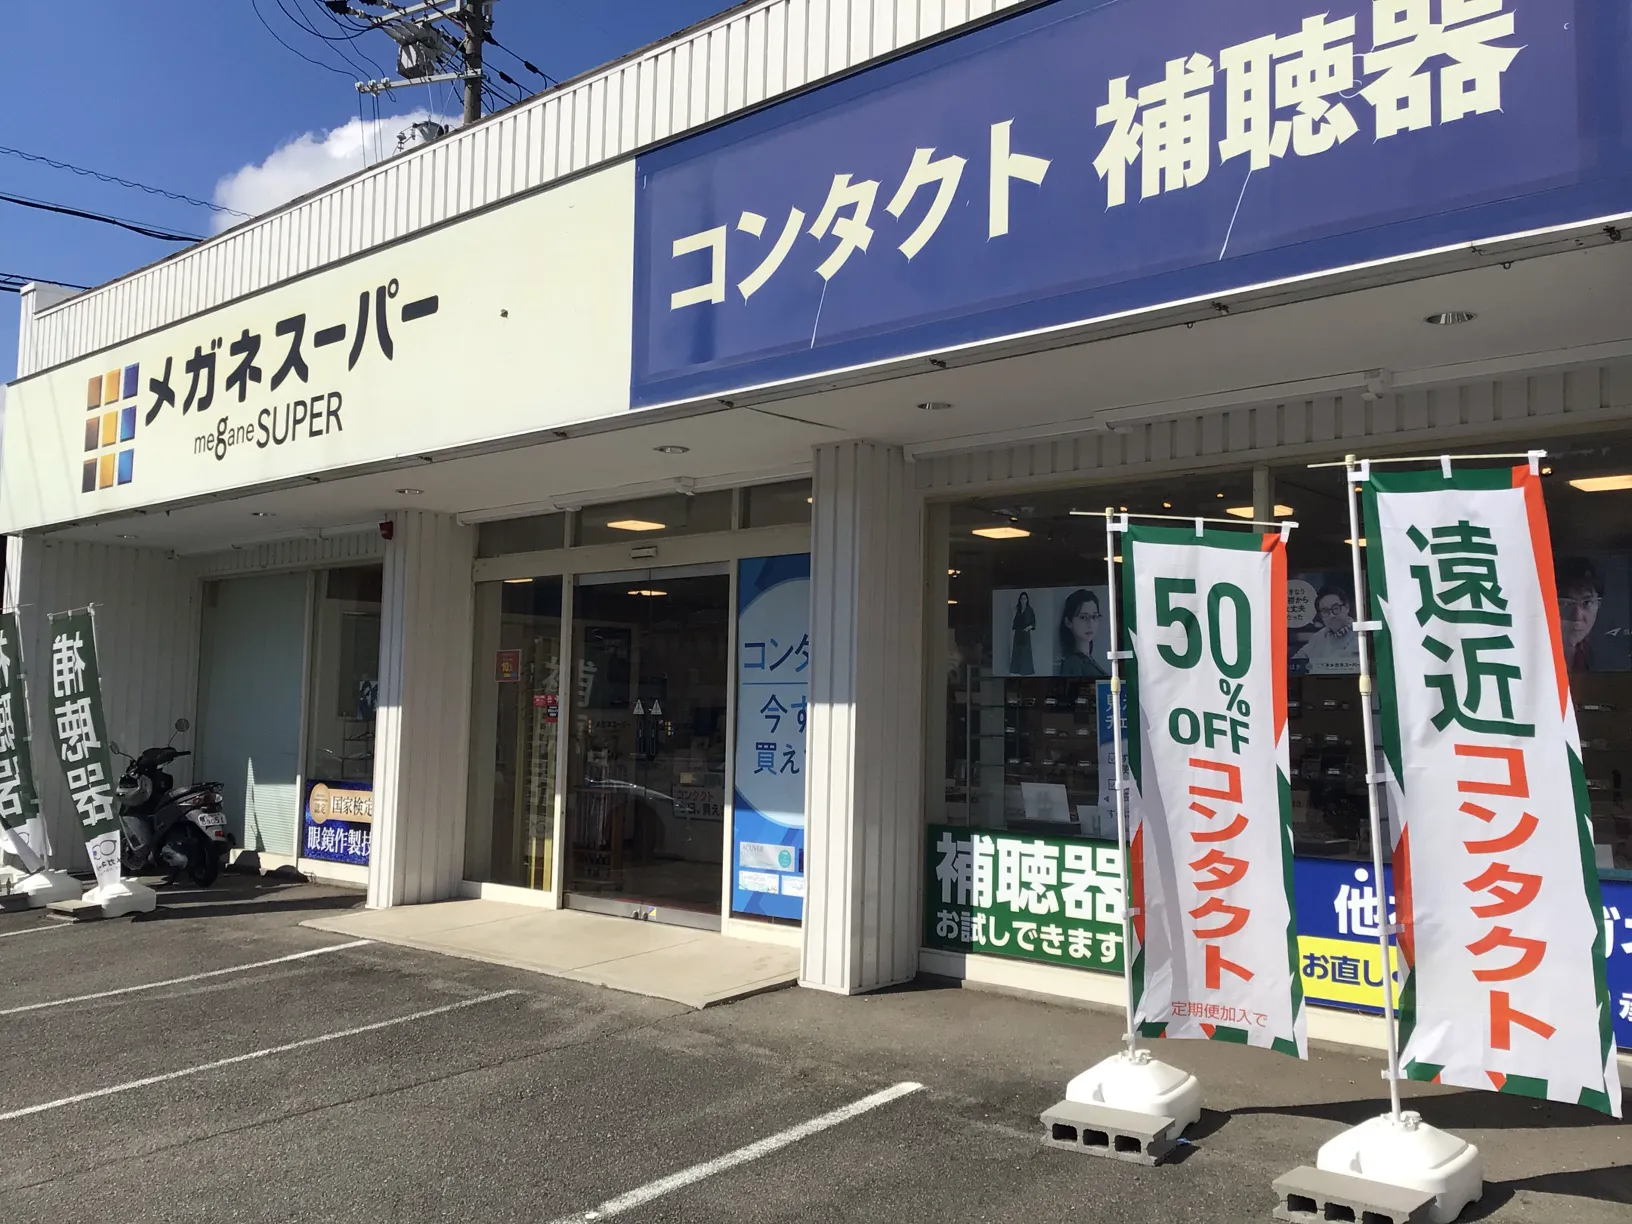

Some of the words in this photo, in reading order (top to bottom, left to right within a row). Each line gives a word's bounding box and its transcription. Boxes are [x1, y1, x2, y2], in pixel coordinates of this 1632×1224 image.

[669, 117, 1053, 310] コンタクト
[1092, 0, 1526, 212] 補聴器
[145, 278, 439, 426] メガネスーパー
[194, 391, 343, 461] meganeSUPER
[1406, 520, 1535, 738] 遠近
[754, 742, 806, 775] 買え
[1168, 707, 1250, 755] OFF
[936, 832, 1129, 924] 補聴器
[1188, 757, 1255, 990] コンタクト
[1454, 743, 1557, 1051] コンタクト
[936, 909, 1124, 964] お試しできます
[1302, 952, 1397, 989] お直し
[1171, 1001, 1268, 1028] 定期便加入で
